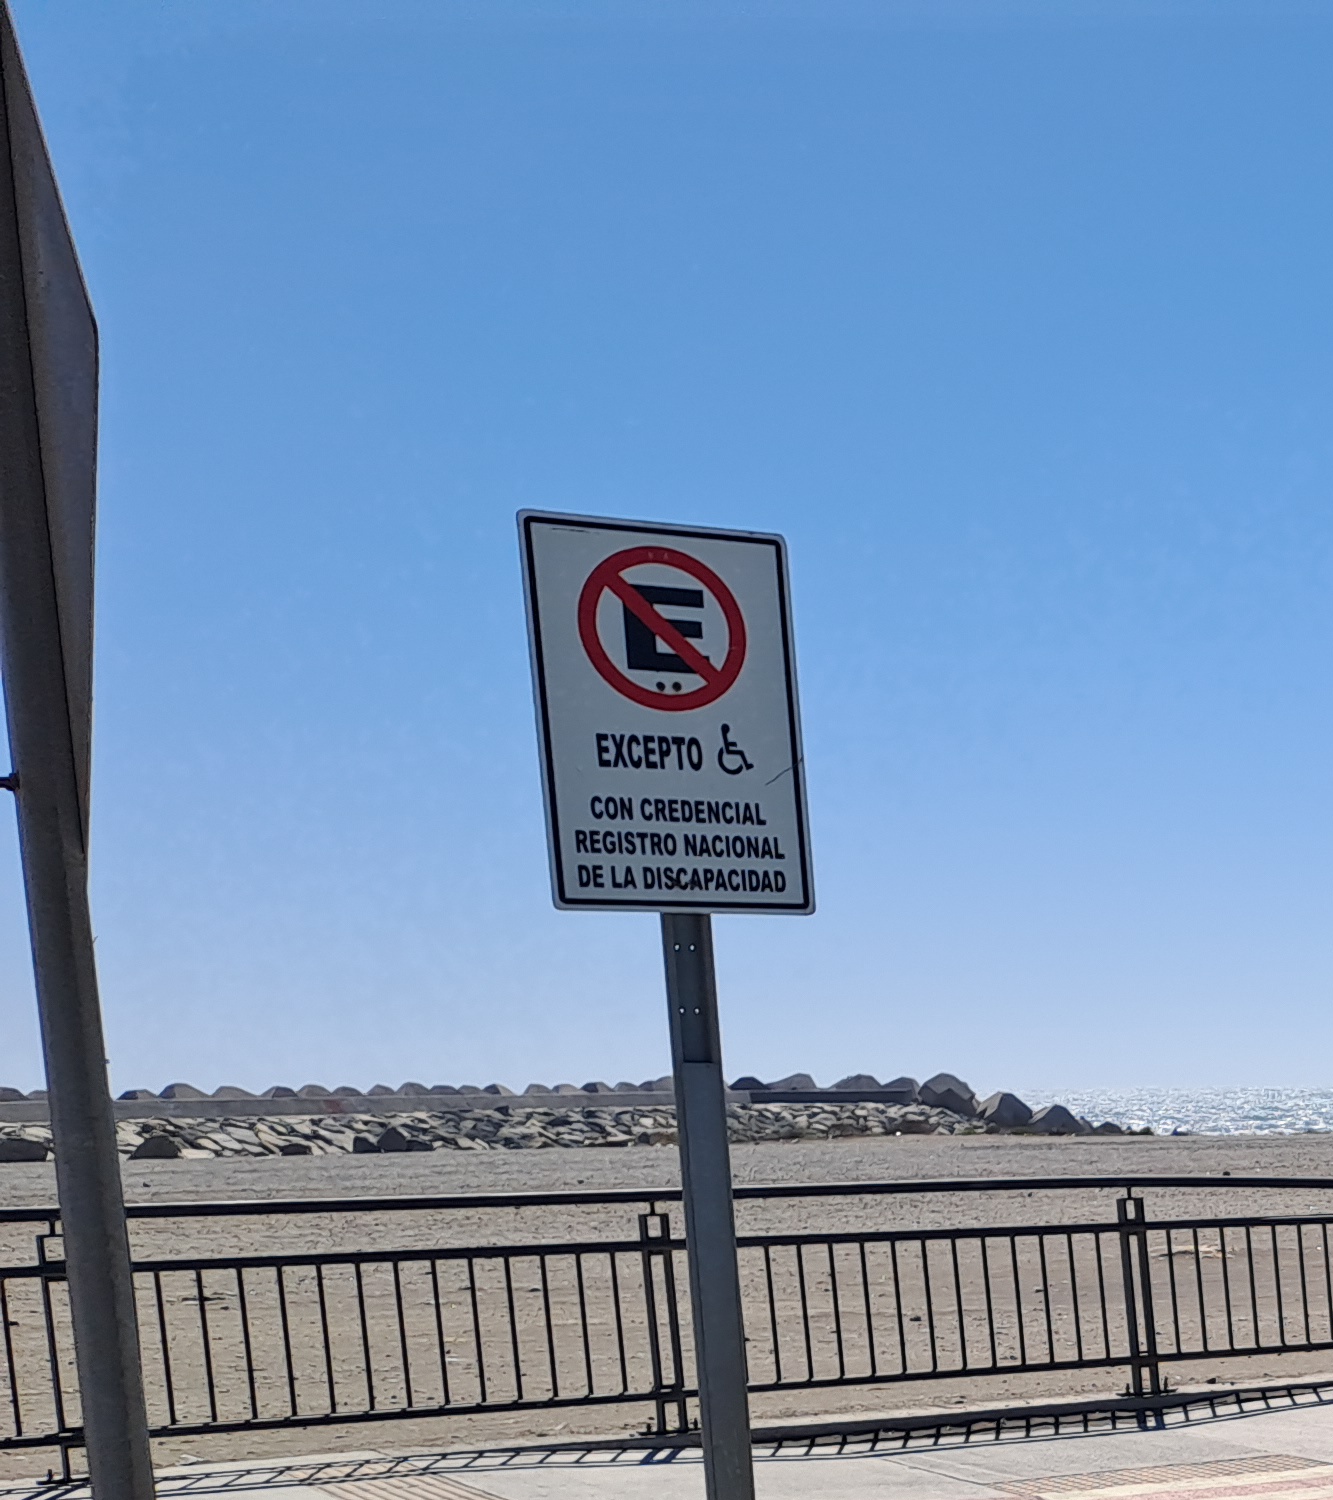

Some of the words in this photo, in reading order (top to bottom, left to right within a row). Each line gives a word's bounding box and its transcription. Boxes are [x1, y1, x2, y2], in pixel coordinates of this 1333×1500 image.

[624, 584, 710, 674] E
[596, 732, 703, 771] EXCEPTO
[590, 796, 633, 821] CON
[641, 798, 767, 826] CREDENCIAL
[575, 830, 677, 856] REGISTRO
[684, 834, 785, 860] NACIONAL
[577, 864, 603, 889] DE
[611, 865, 637, 889] LA
[643, 866, 786, 893] DISCAPACIDAD
